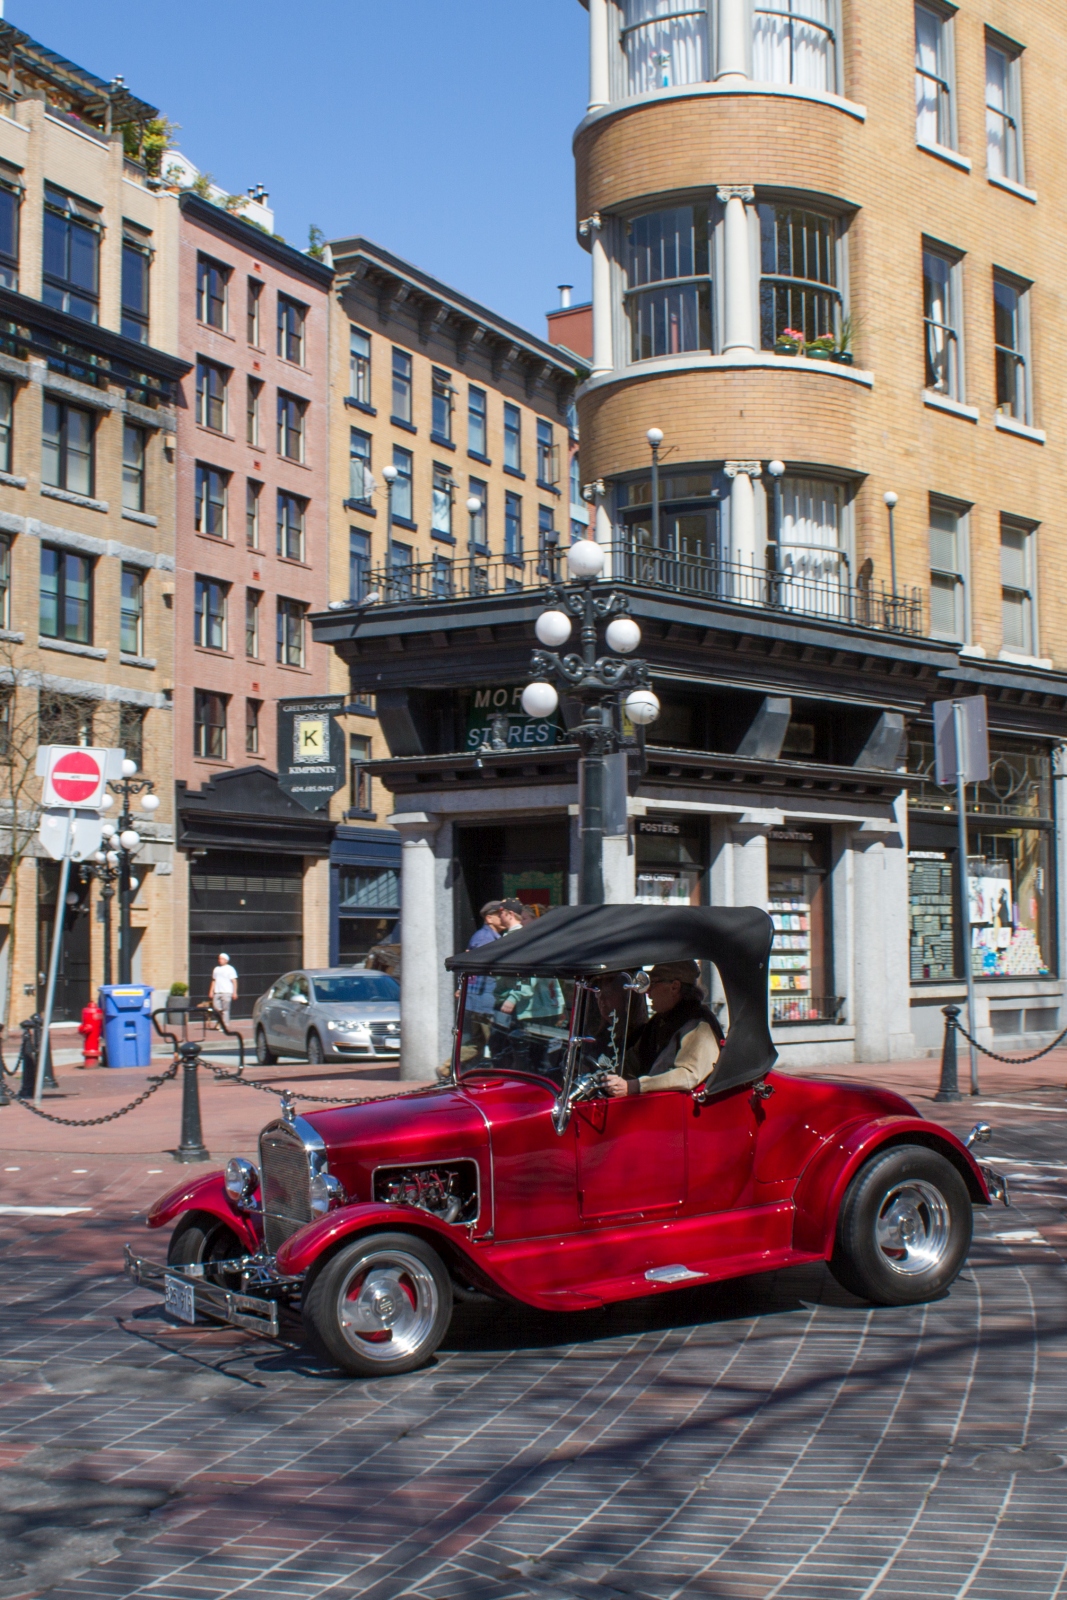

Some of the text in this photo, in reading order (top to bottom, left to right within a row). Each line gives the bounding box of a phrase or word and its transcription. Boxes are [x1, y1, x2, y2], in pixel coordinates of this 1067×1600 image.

[475, 688, 524, 708] MOR
[283, 702, 341, 712] GREETING CARDS
[304, 730, 318, 746] K
[467, 724, 549, 746] STRES
[288, 766, 336, 774] KIMPRINTS
[640, 823, 679, 834] POSTERS
